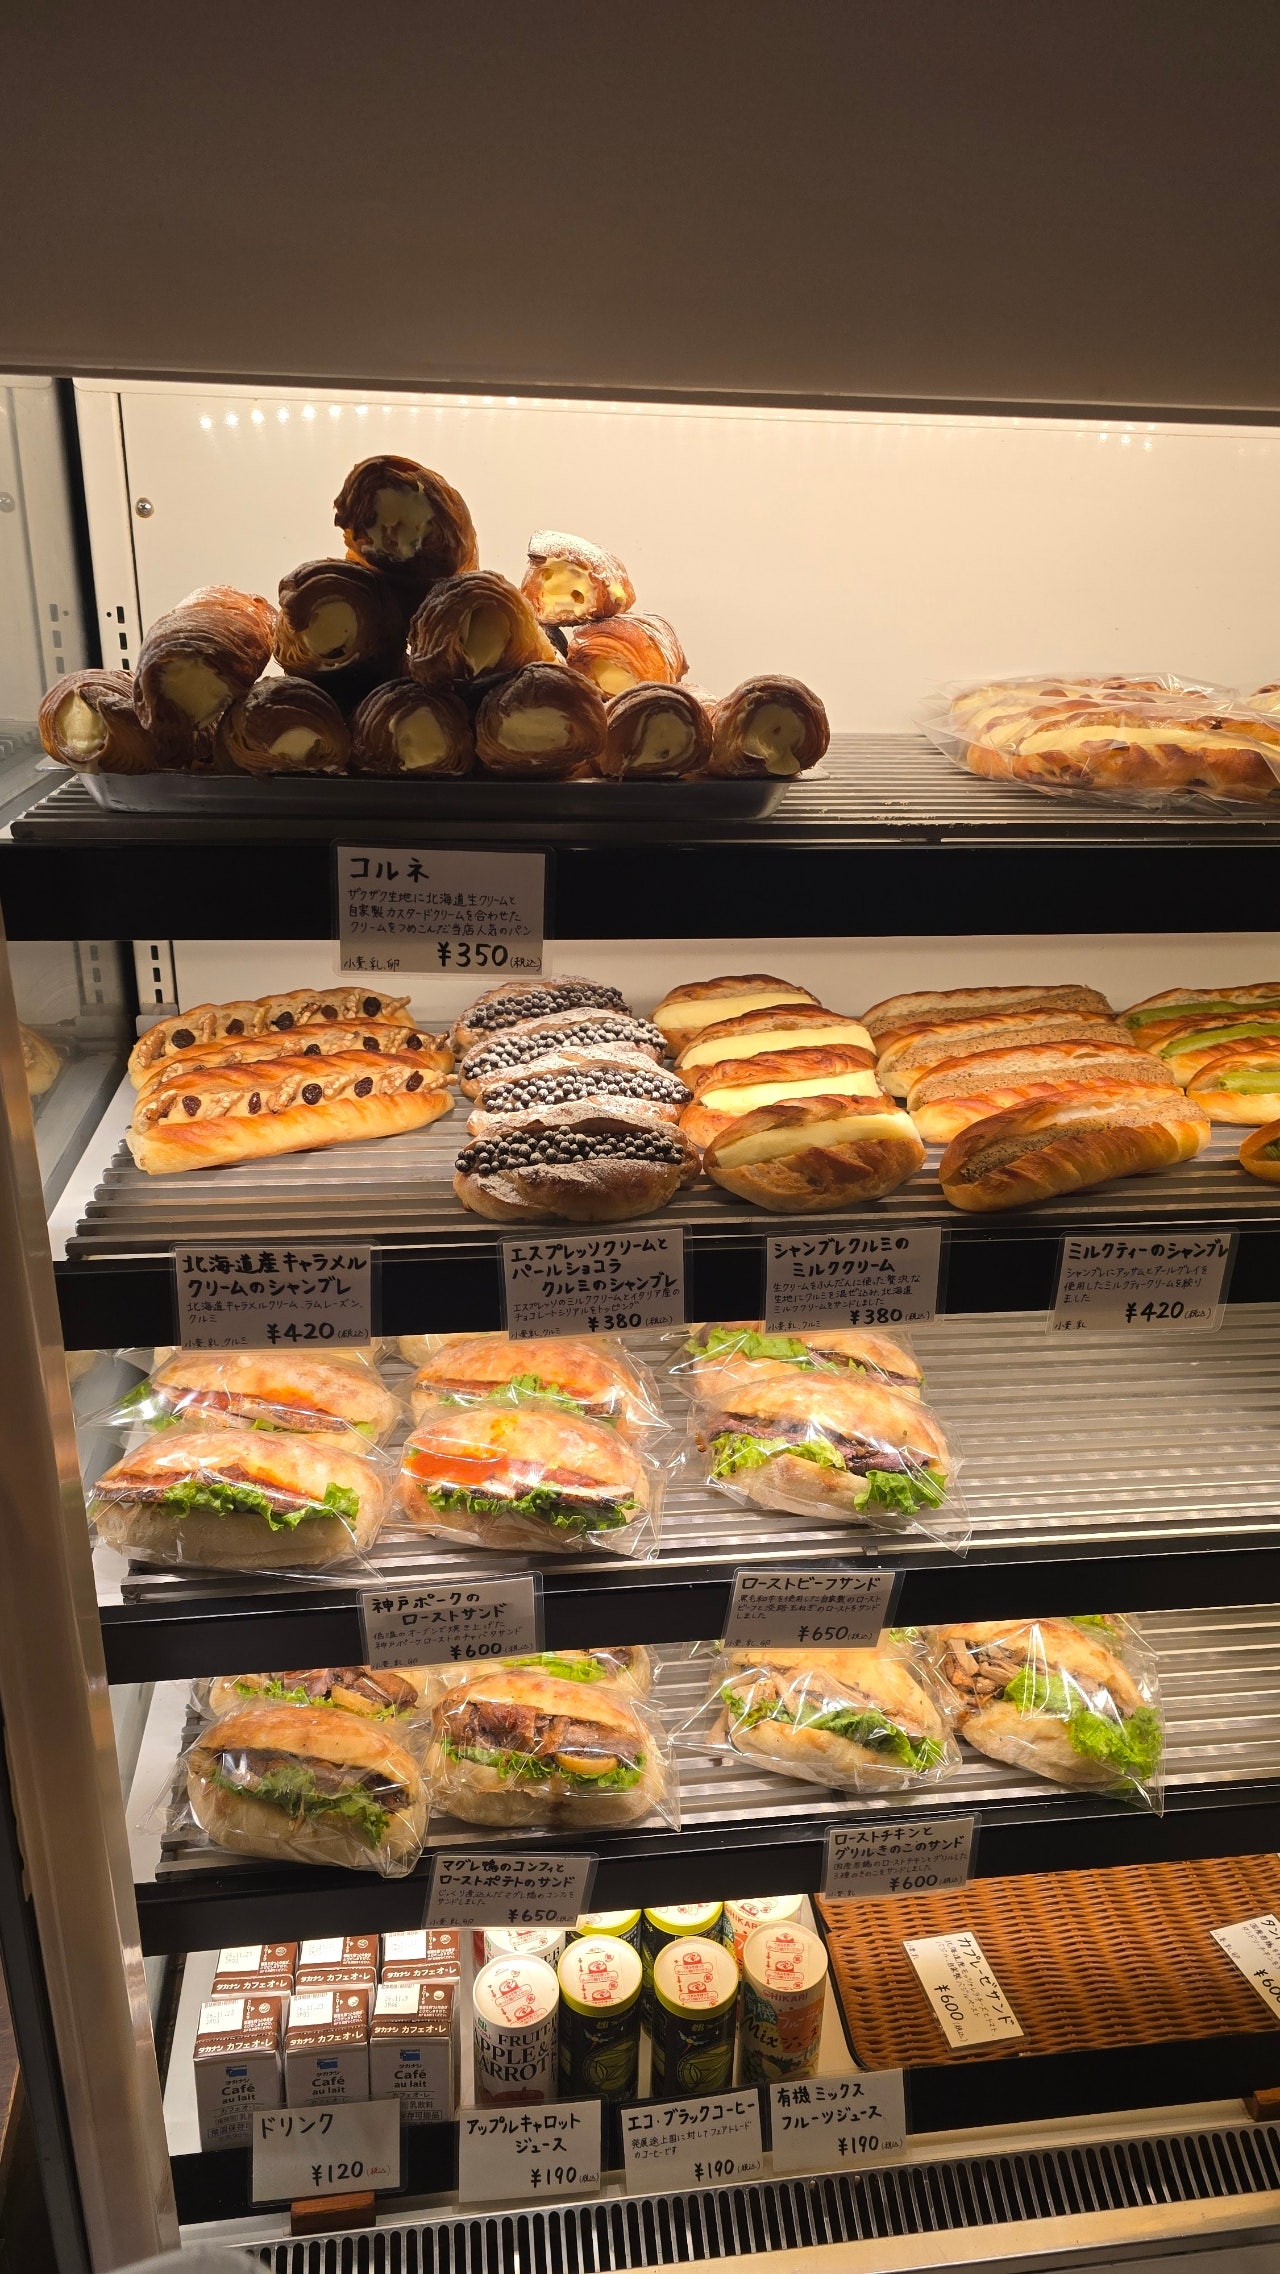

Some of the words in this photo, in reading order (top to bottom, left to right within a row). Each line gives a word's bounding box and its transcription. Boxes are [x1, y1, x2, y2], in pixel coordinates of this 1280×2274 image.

[350, 857, 429, 883] コルネ
[348, 888, 516, 908] ザクザク生地に北海道生クリームと
[350, 904, 522, 922] 自家製カスタードクリームを合わせた
[351, 921, 531, 937] クリームをつめこんだ当店人気のパン
[437, 941, 508, 968] ¥350
[511, 1238, 669, 1263] エスプレッソクリームと
[774, 1237, 910, 1260] シャンブレクルミの
[1068, 1239, 1229, 1260] ミルクティーのシャンブレ
[182, 1250, 367, 1275] 北海道産キャラメル
[512, 1259, 622, 1280] パールショコラ
[792, 1259, 896, 1278] ミルククリーム
[1066, 1265, 1208, 1278] シャンブレにアッサムとアールグレイを
[188, 1275, 351, 1298] クリームのシャンブレ
[542, 1271, 677, 1298] クルミのシャンブレ
[1063, 1278, 1202, 1292] 使用したミルクティークリームを絞り
[513, 1288, 680, 1313] エスプレッソのミルククリームとイタリア産の
[774, 1298, 885, 1314] ミルククリームをサンドしました
[1063, 1293, 1091, 1304] ました
[189, 1314, 217, 1325] クルミ
[514, 1301, 640, 1322] チョコレートシリアルをトッピング
[850, 1308, 903, 1325] ¥380
[1125, 1301, 1185, 1323] ¥420
[588, 1313, 642, 1332] ¥380
[266, 1322, 335, 1345] ¥420
[741, 1576, 881, 1592] ローストビーフサンド
[371, 1593, 480, 1614] 神戸ポークの
[401, 1602, 508, 1626] ローストサンド
[797, 1625, 849, 1643] ¥650
[450, 1642, 502, 1660] ¥600
[835, 1826, 933, 1846] ローストチキンと
[834, 1835, 965, 1861] グリルきのこのサンド
[442, 1858, 565, 1874] マグレ鴨のコンフィと
[439, 1874, 576, 1888] ローストポテトのサンド
[889, 1874, 938, 1892] ¥600
[508, 1908, 558, 1924] ¥650
[956, 1937, 1015, 2025] カプレーゼサンド
[934, 1984, 964, 2021] ¥600
[741, 2014, 779, 2048] Mix
[312, 2076, 345, 2087] Café
[394, 2069, 428, 2080] Café
[410, 2080, 427, 2088] lait
[222, 2082, 255, 2095] Café
[328, 2086, 346, 2094] lait
[222, 2097, 237, 2105] au
[238, 2094, 256, 2102] lait
[261, 2113, 333, 2139] ドリンク
[467, 2112, 581, 2135] アップルキャロット
[628, 2101, 755, 2131] エコ・ブラックコーヒー
[782, 2105, 882, 2130] フルーツジュース
[515, 2137, 567, 2154] ジュース
[631, 2121, 752, 2149] 発展途上国に対してフェアトレード
[838, 2135, 880, 2156] ¥190
[634, 2146, 677, 2159] のコーヒーです
[311, 2161, 364, 2187] ¥120
[530, 2166, 577, 2188] ¥190
[694, 2159, 735, 2182] ¥190
